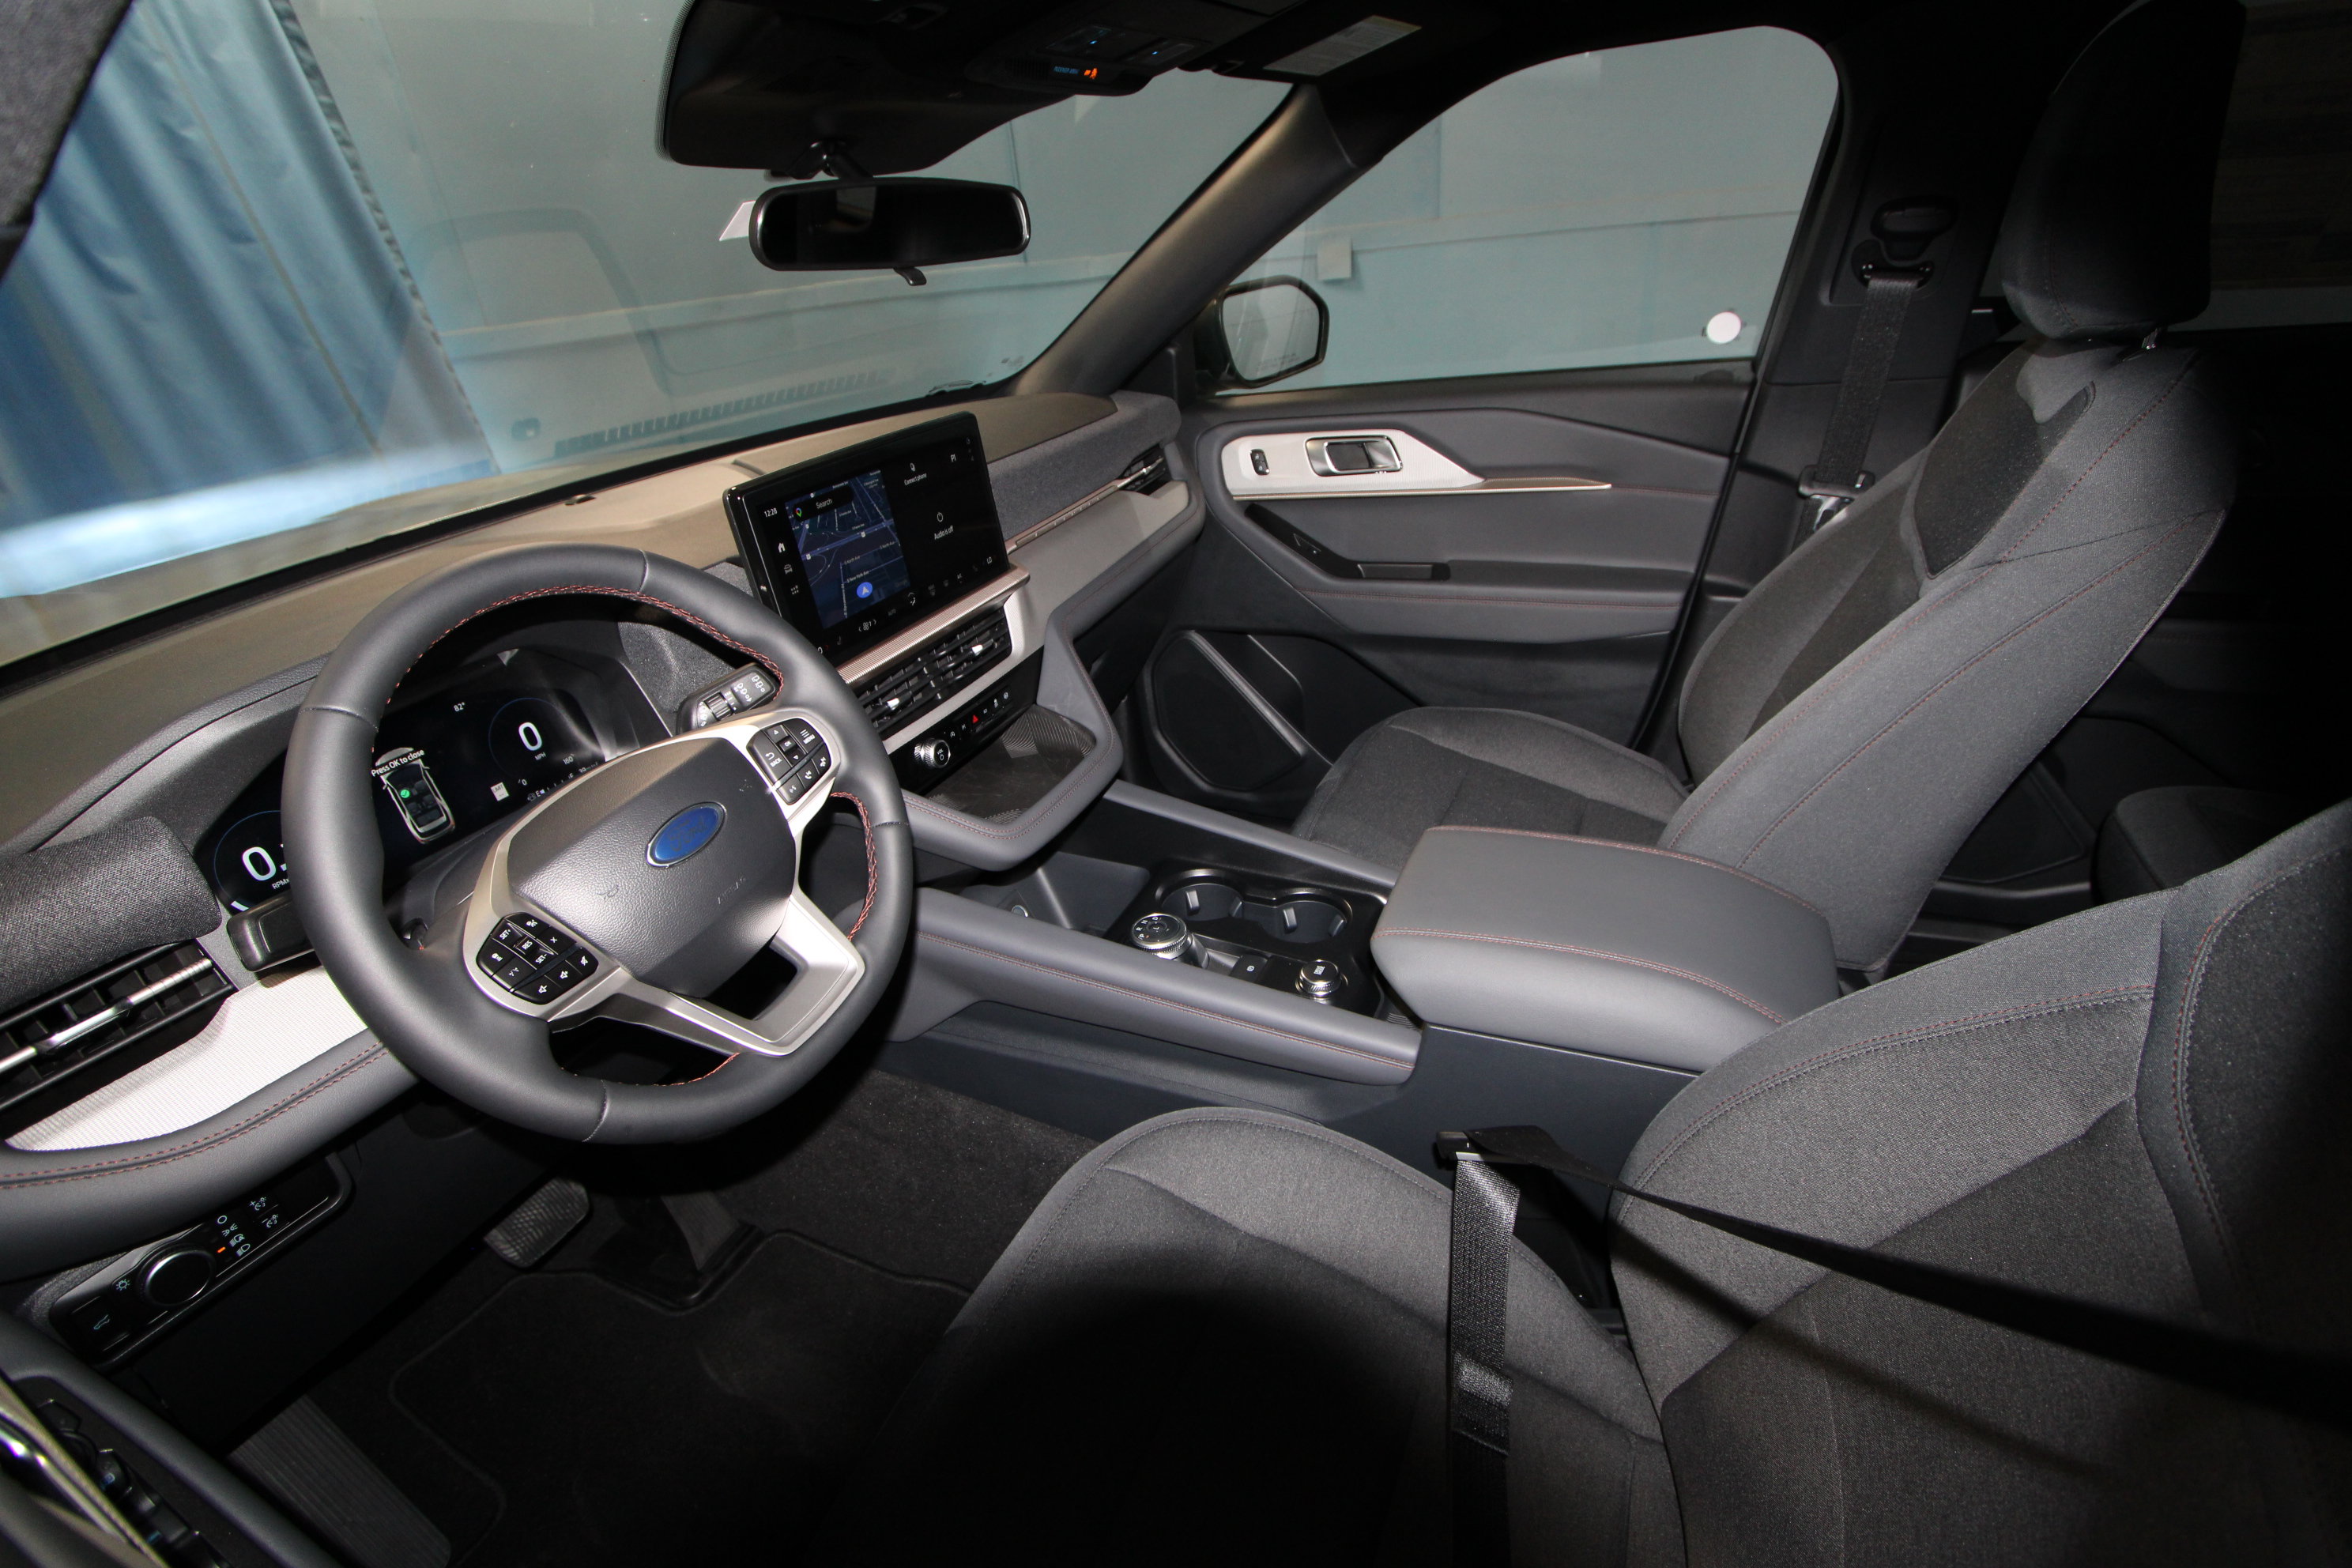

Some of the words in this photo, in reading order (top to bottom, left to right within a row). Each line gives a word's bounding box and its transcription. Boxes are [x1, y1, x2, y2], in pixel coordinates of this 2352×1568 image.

[904, 477, 917, 485] Connect
[917, 473, 927, 481] phone
[816, 498, 833, 509] Search
[934, 530, 945, 540] Audio
[518, 722, 543, 751] 0
[803, 733, 816, 744] MENU
[534, 752, 546, 760] MPH
[563, 756, 574, 766] 160
[371, 764, 390, 777] Press
[388, 759, 401, 769] OK
[399, 756, 408, 765] to
[407, 749, 425, 761] close
[770, 757, 782, 767] BACK
